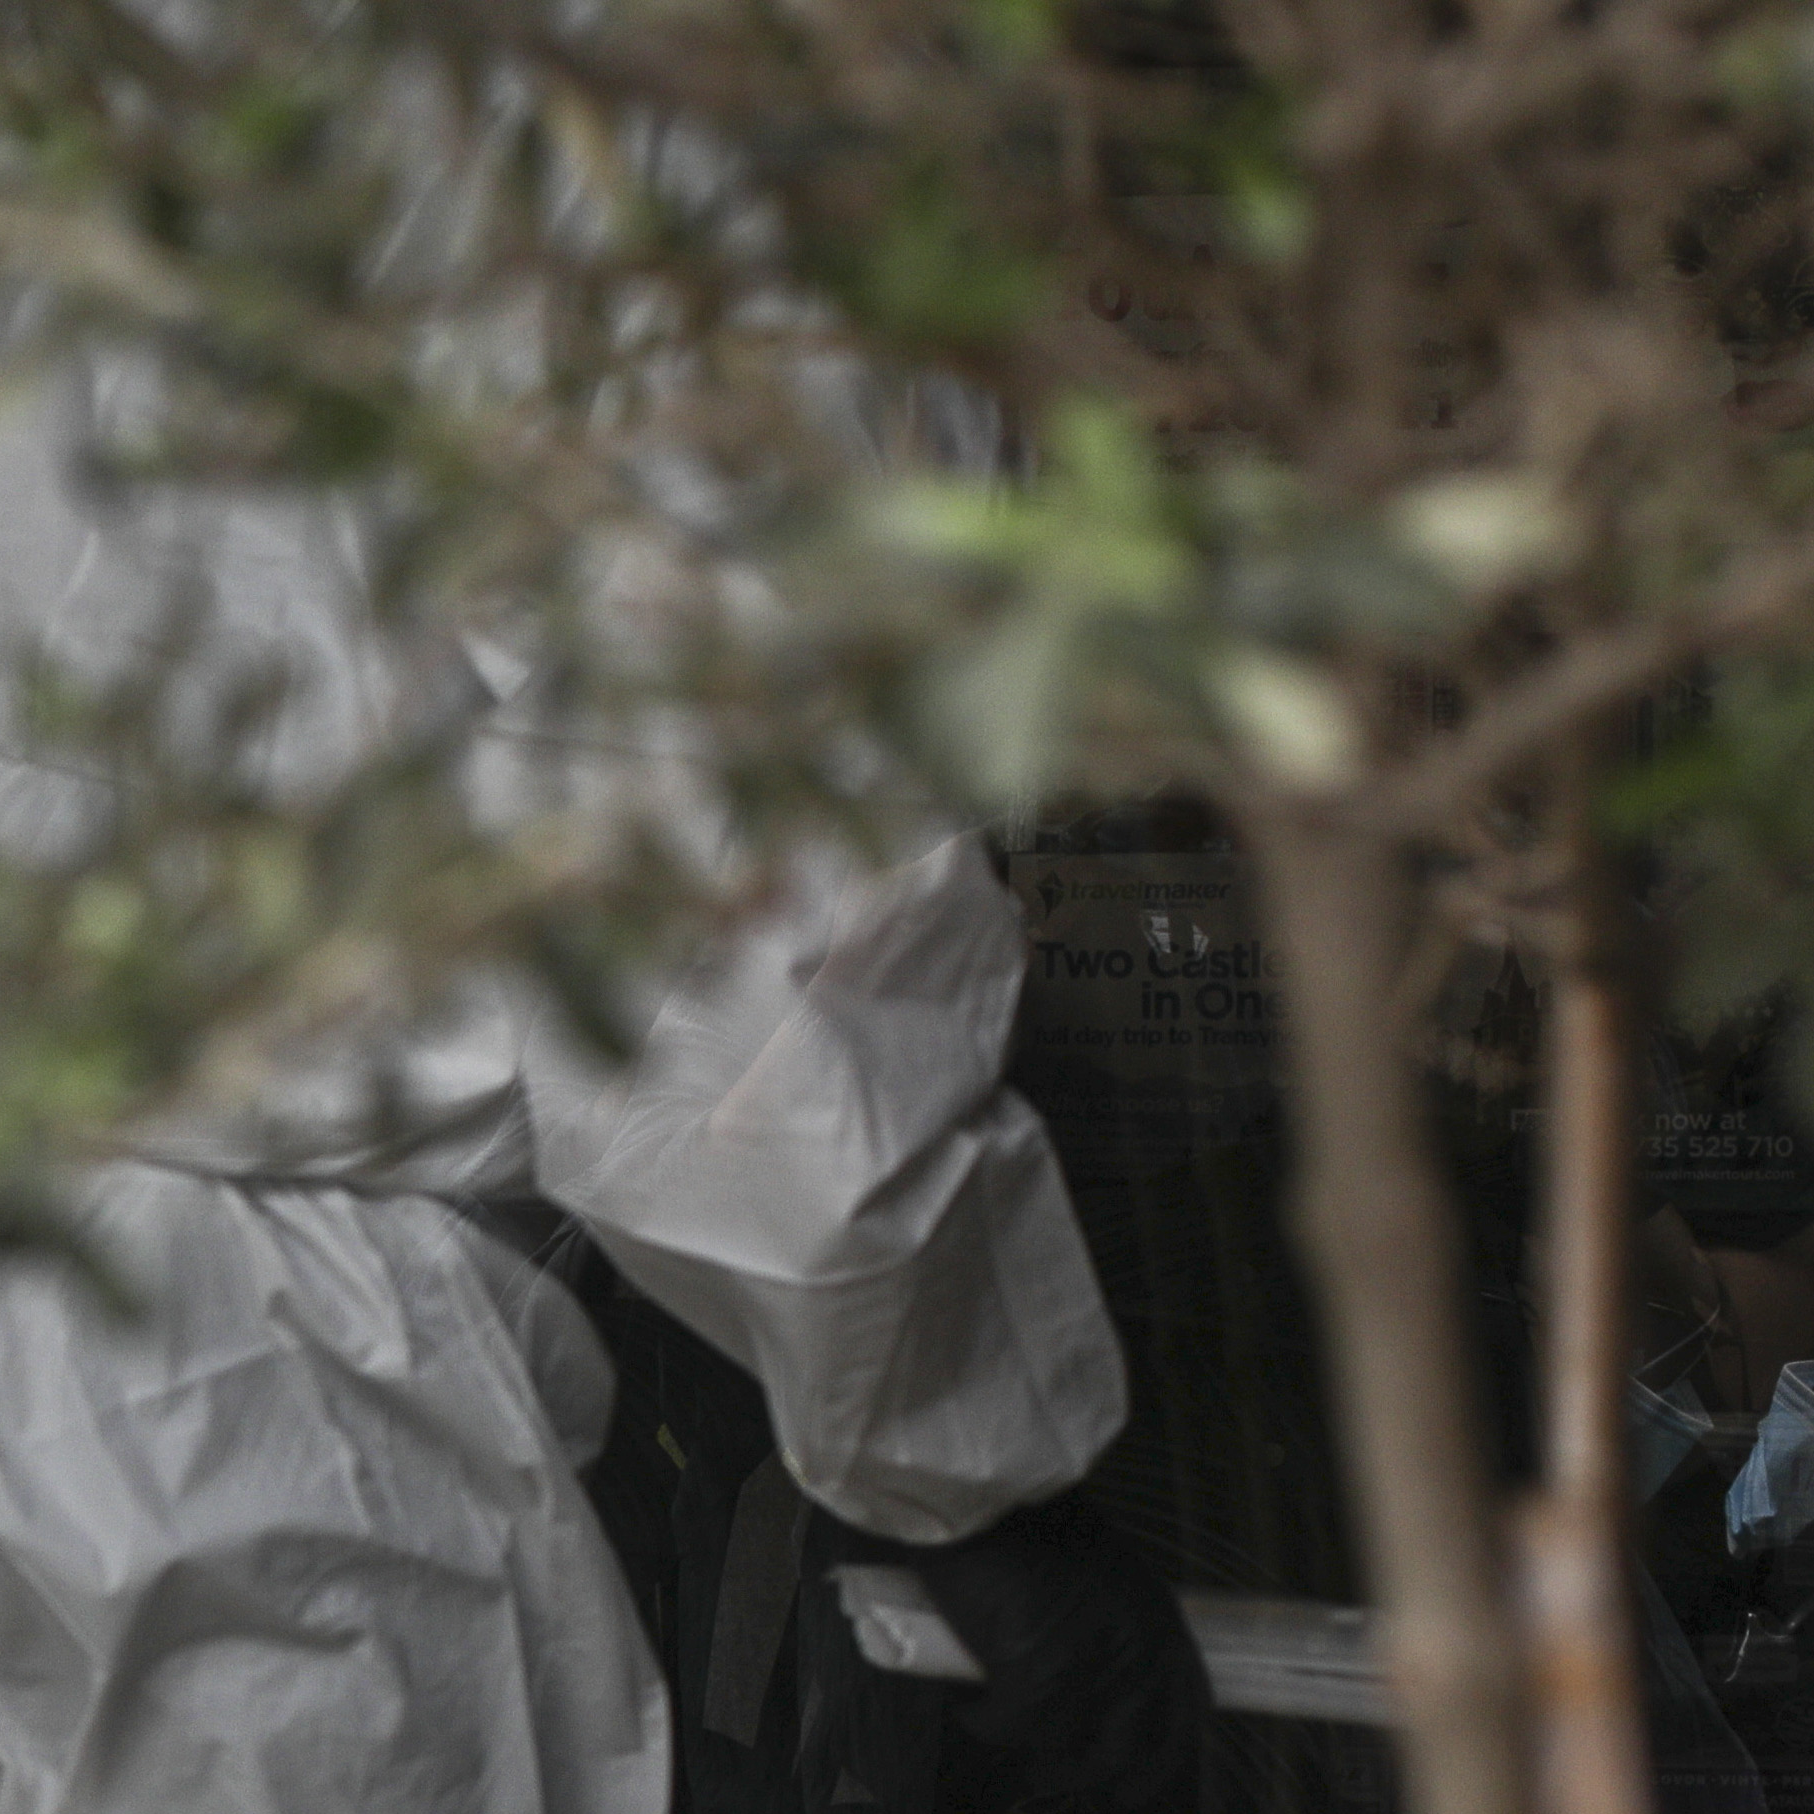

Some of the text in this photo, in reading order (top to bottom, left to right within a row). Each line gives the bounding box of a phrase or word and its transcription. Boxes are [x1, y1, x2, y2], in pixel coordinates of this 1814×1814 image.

[1070, 880, 1232, 901] travelmaker
[1034, 941, 1135, 979] Two
[1141, 981, 1181, 1019] in
[1075, 1026, 1116, 1048] day
[1123, 1026, 1163, 1048] trip
[1168, 1027, 1193, 1046] to
[1099, 1094, 1181, 1114] choose
[1187, 1094, 1225, 1114] us?
[1654, 1113, 1713, 1131] now
[1719, 1110, 1748, 1131] at
[1688, 1135, 1738, 1158] 525
[1746, 1135, 1795, 1158] 710
